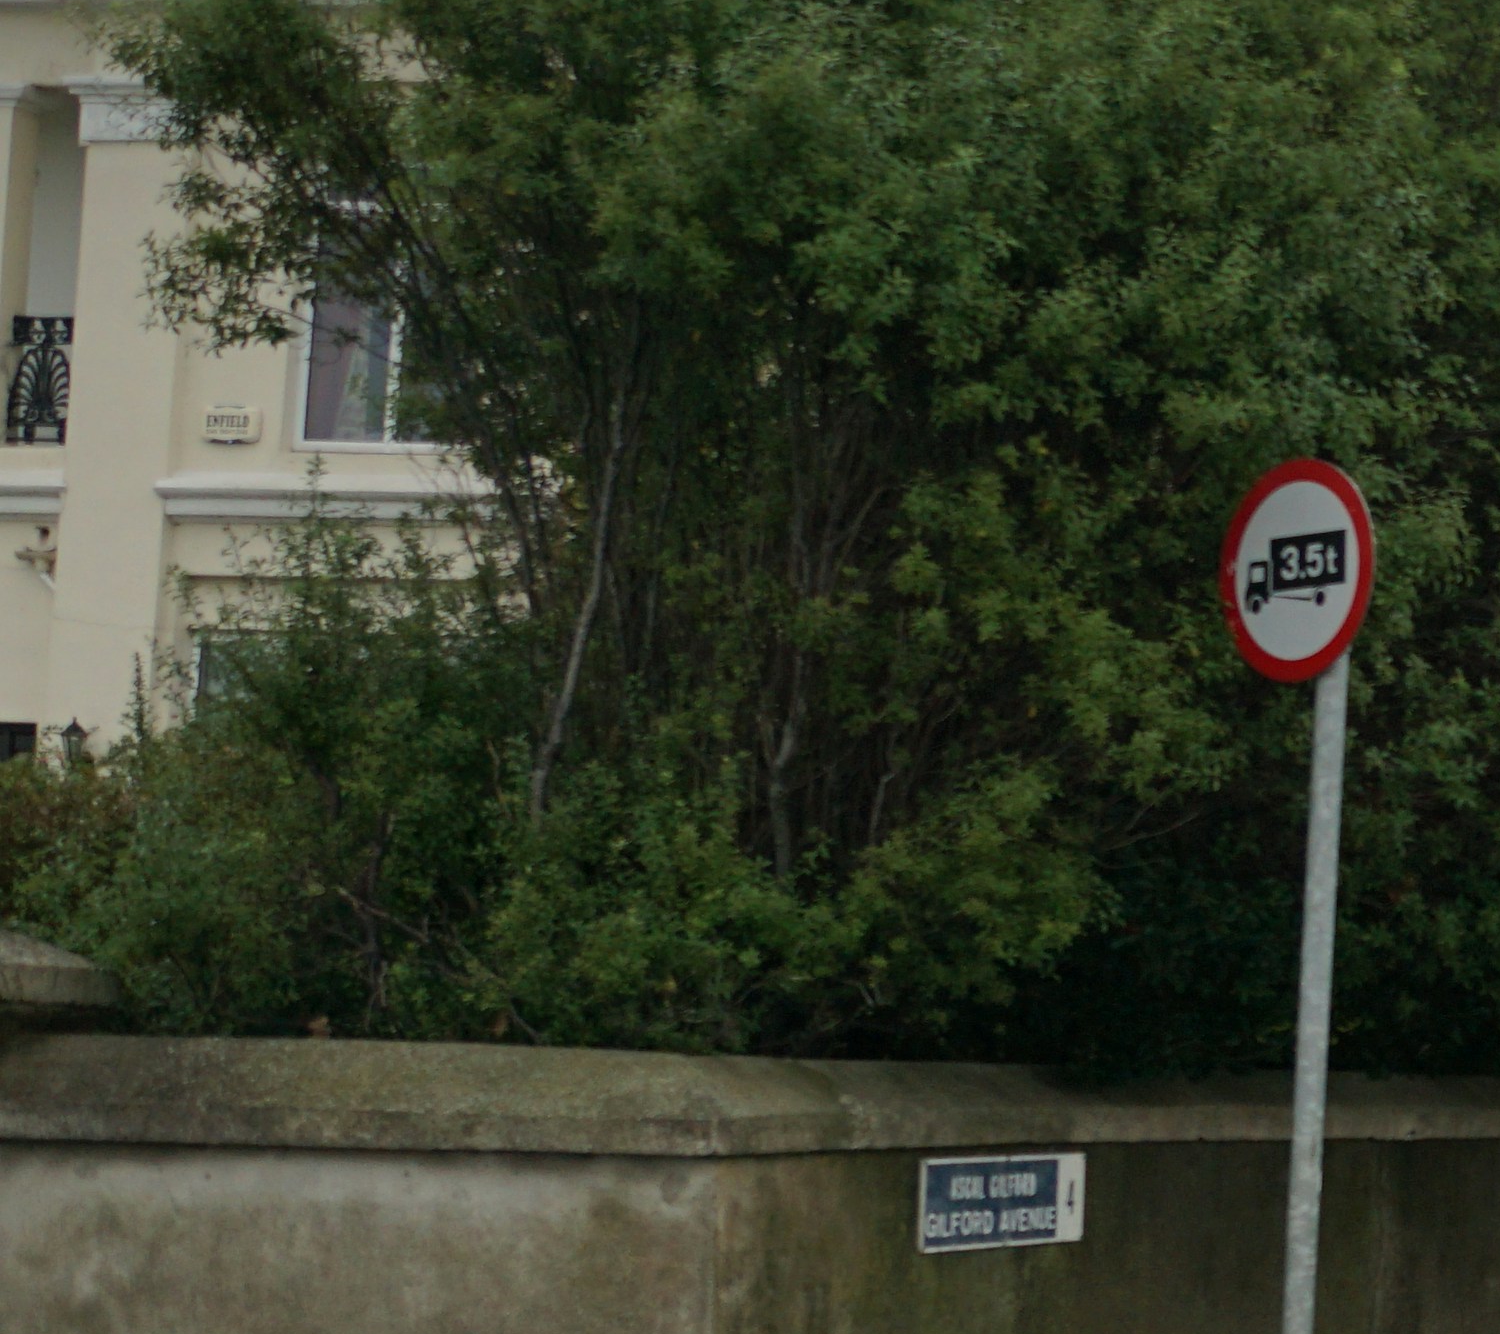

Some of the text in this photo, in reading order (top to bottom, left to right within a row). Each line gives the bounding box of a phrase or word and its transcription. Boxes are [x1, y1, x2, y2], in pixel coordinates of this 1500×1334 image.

[1279, 542, 1339, 582] 3.5t
[925, 1206, 1057, 1238] GILFORD AVENUE
